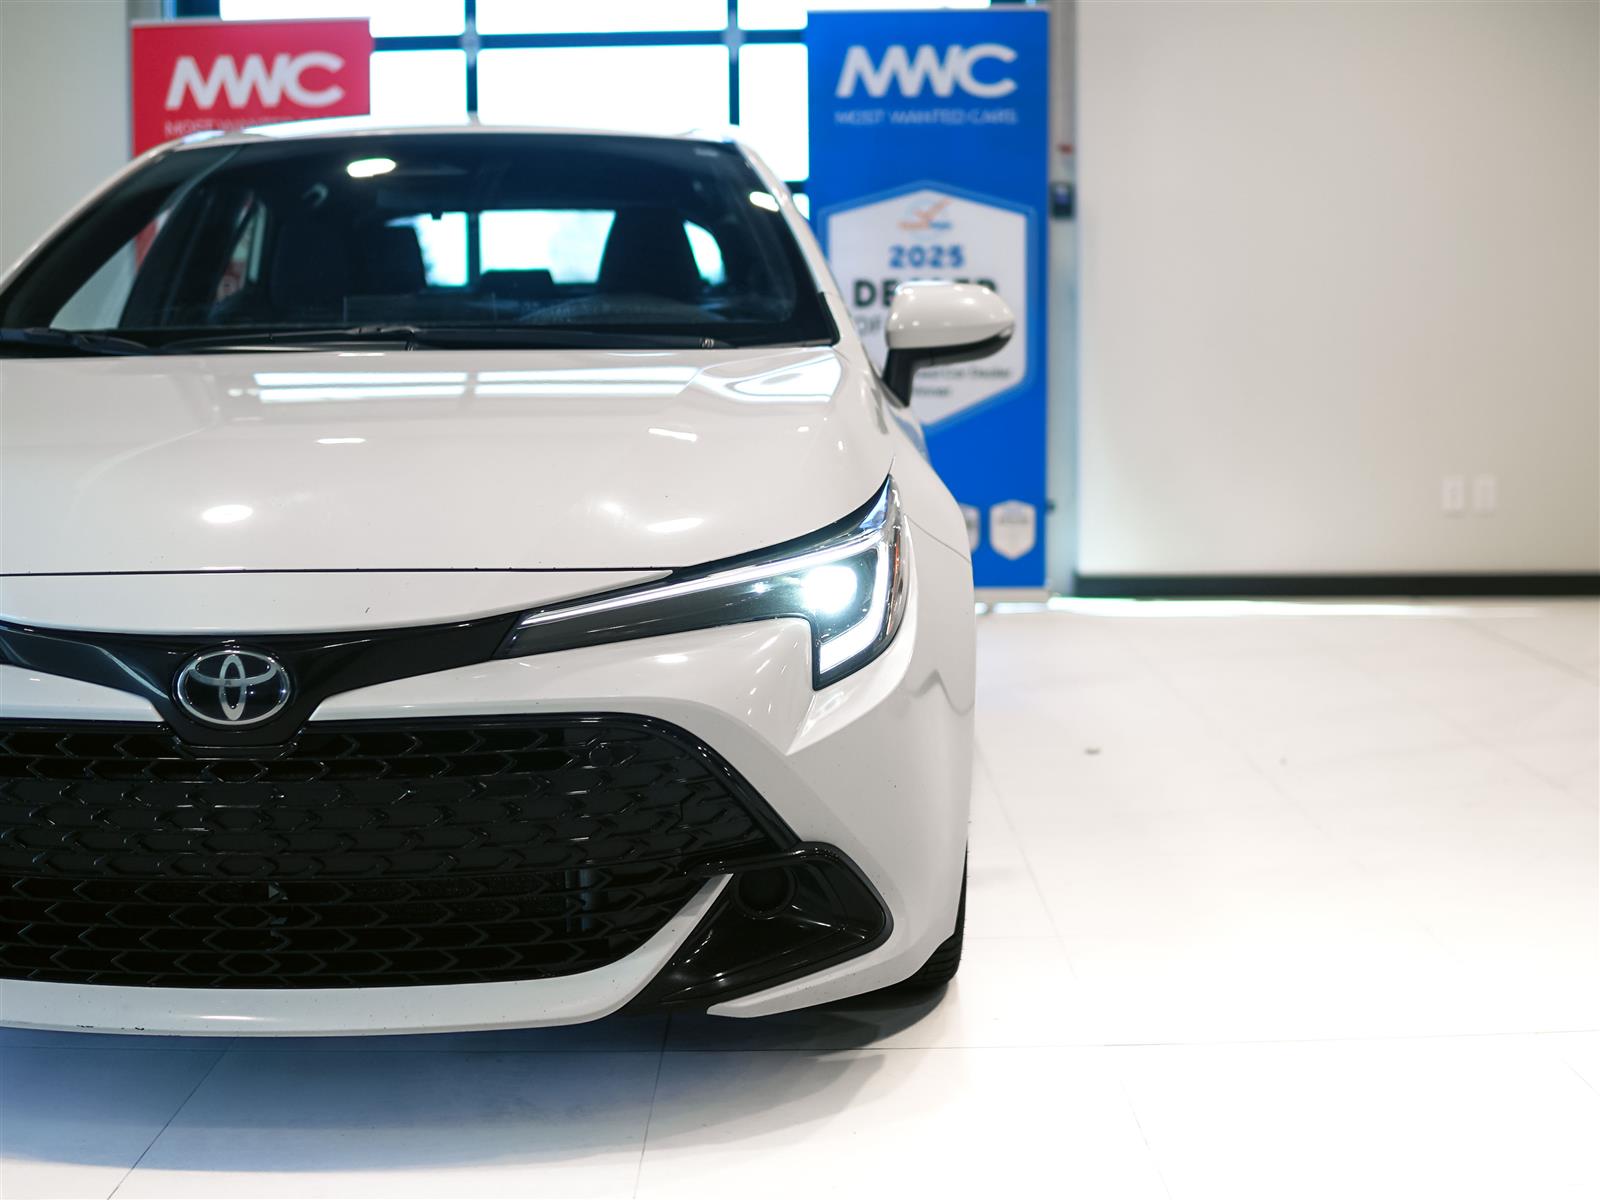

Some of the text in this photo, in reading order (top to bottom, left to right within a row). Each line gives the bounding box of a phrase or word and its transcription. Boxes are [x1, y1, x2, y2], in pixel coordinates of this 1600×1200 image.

[165, 51, 345, 111] MWC
[836, 43, 1018, 98] MWC
[889, 245, 965, 268] 2025
